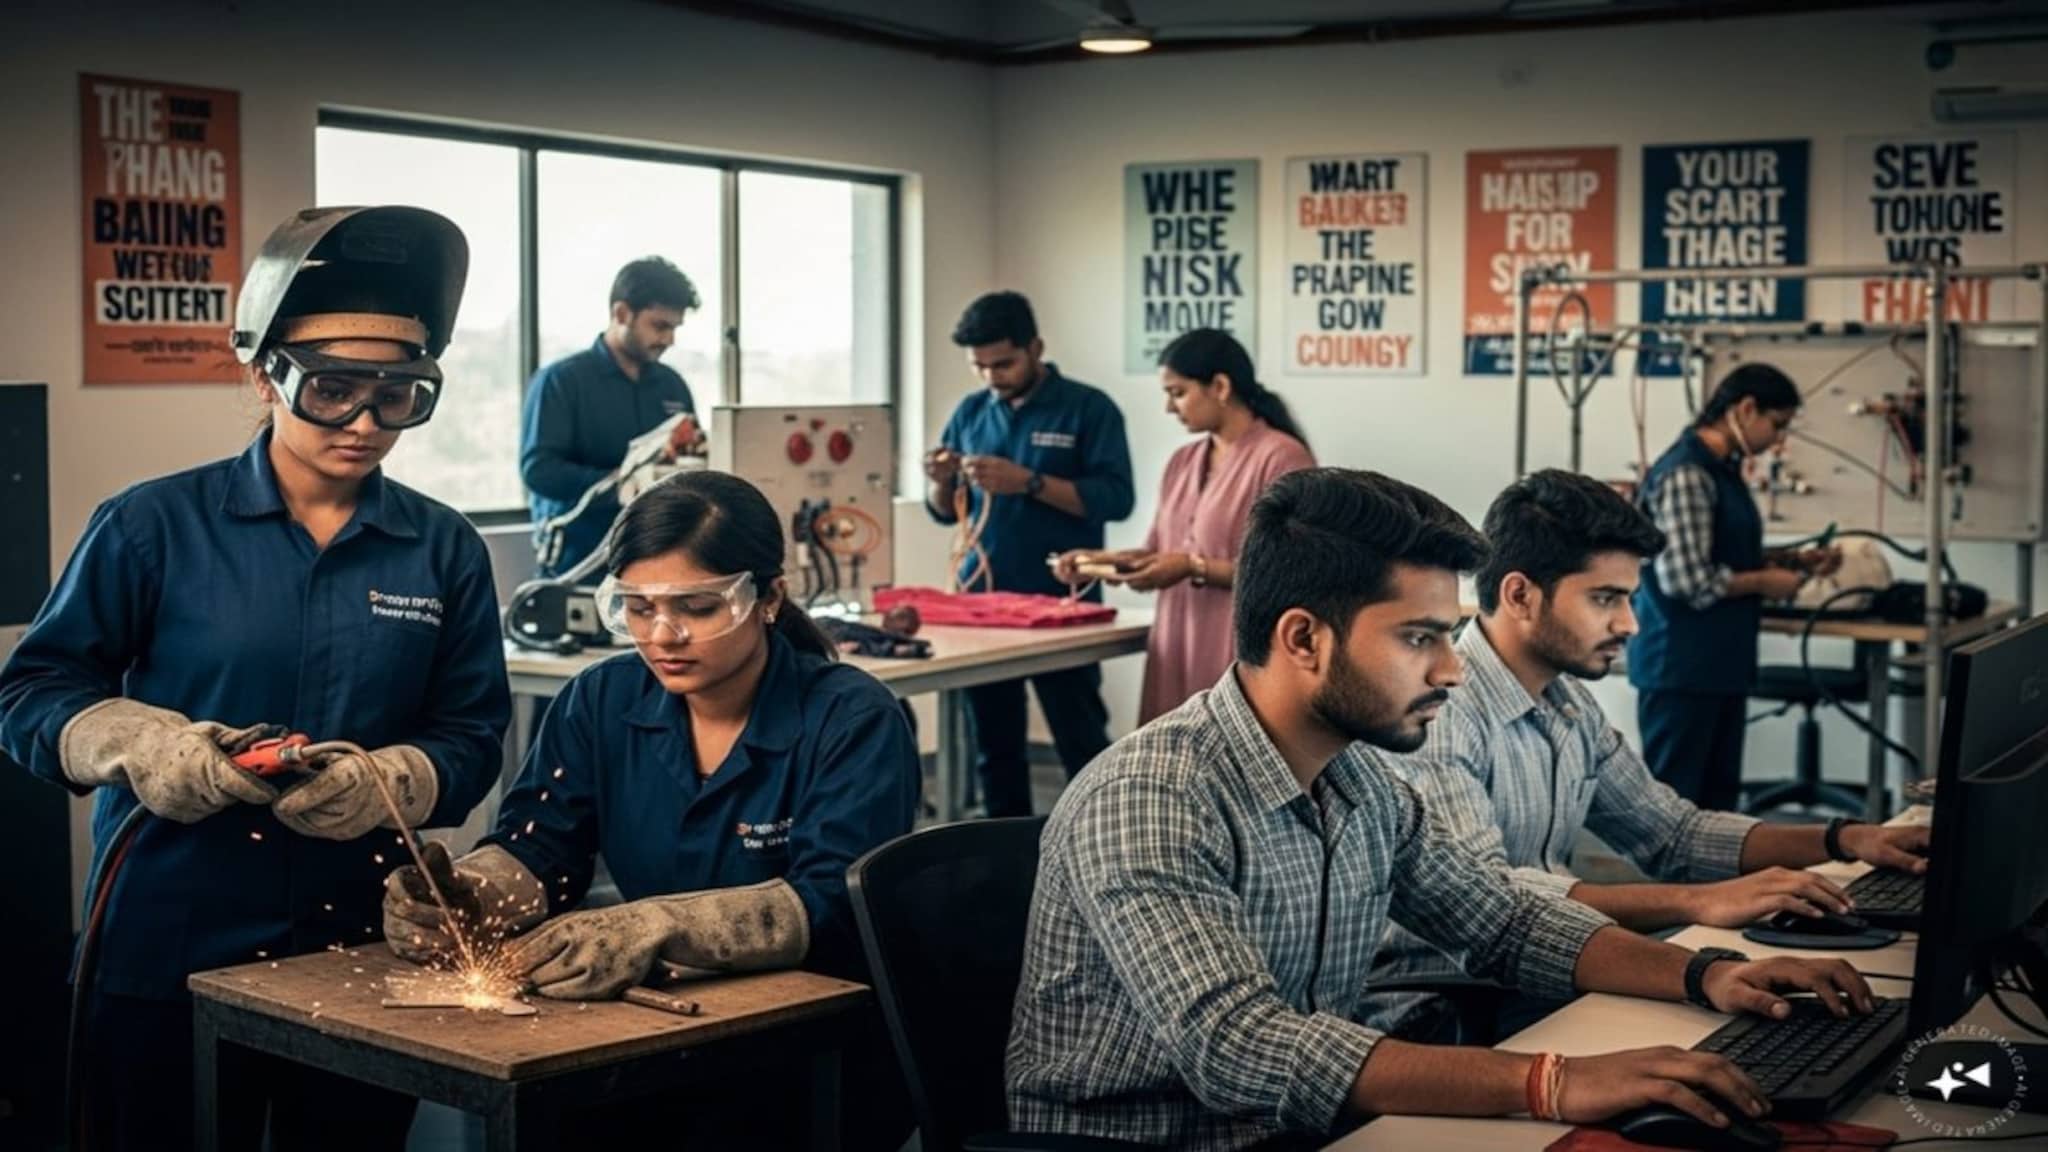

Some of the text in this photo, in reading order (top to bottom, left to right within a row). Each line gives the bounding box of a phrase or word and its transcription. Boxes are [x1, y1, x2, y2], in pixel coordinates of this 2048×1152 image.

[93, 83, 163, 141] THE
[1309, 159, 1401, 193] WART
[1676, 151, 1779, 188] YOUR
[1873, 140, 1978, 189] SEVE
[1142, 168, 1236, 215] WHE
[1665, 188, 1787, 225] SCART
[1318, 230, 1374, 260] THE
[1506, 211, 1574, 251] FOR
[1662, 226, 1788, 267] THAGE
[1293, 263, 1415, 295] PRAPINE
[104, 286, 227, 321] SCITERT
[1144, 300, 1235, 334] MOVE
[1319, 298, 1384, 331] GOW
[1298, 334, 1412, 368] COUNGY
